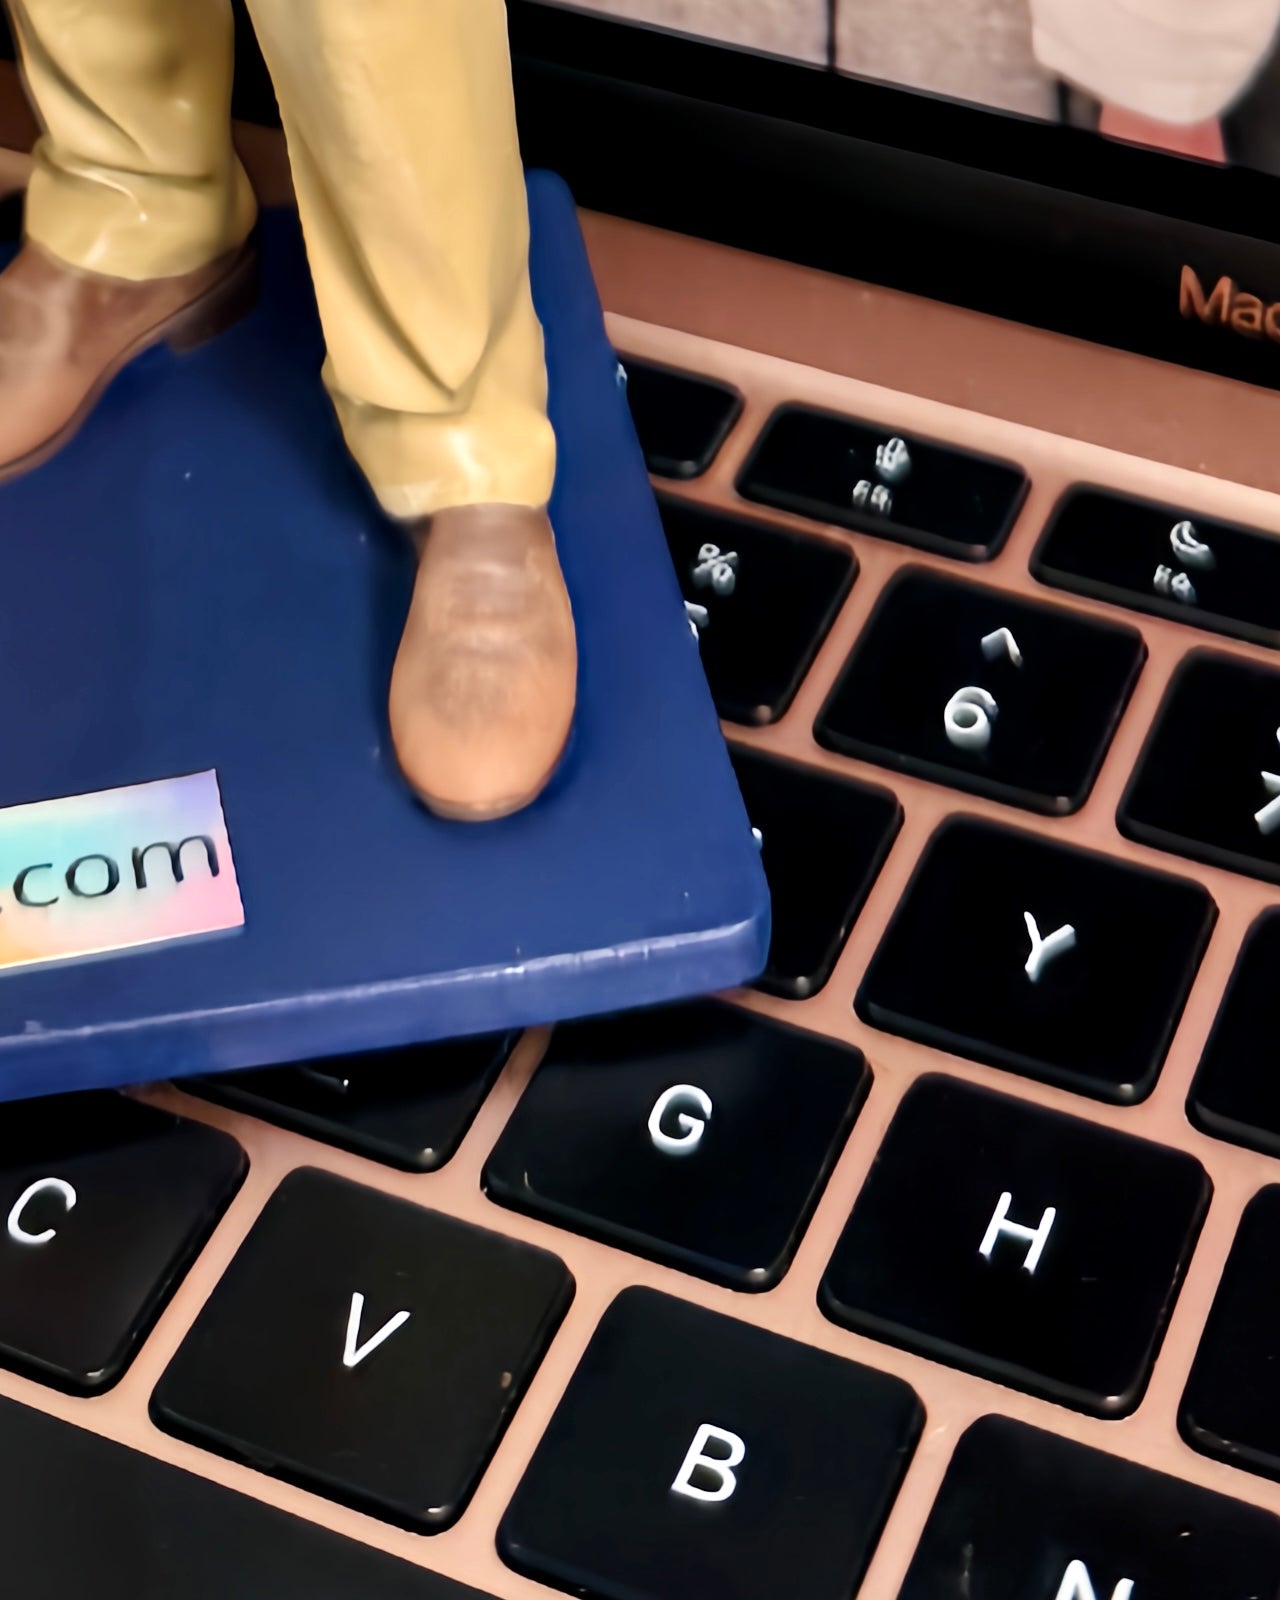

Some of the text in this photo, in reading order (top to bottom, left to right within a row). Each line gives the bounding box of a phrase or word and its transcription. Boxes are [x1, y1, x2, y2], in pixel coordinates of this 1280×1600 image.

[943, 686, 998, 745] 6
[1023, 911, 1076, 982] Y
[647, 1083, 713, 1156] G
[7, 1176, 77, 1247] C
[978, 1191, 1057, 1275] H
[342, 1291, 411, 1369] V
[670, 1423, 746, 1506] B
